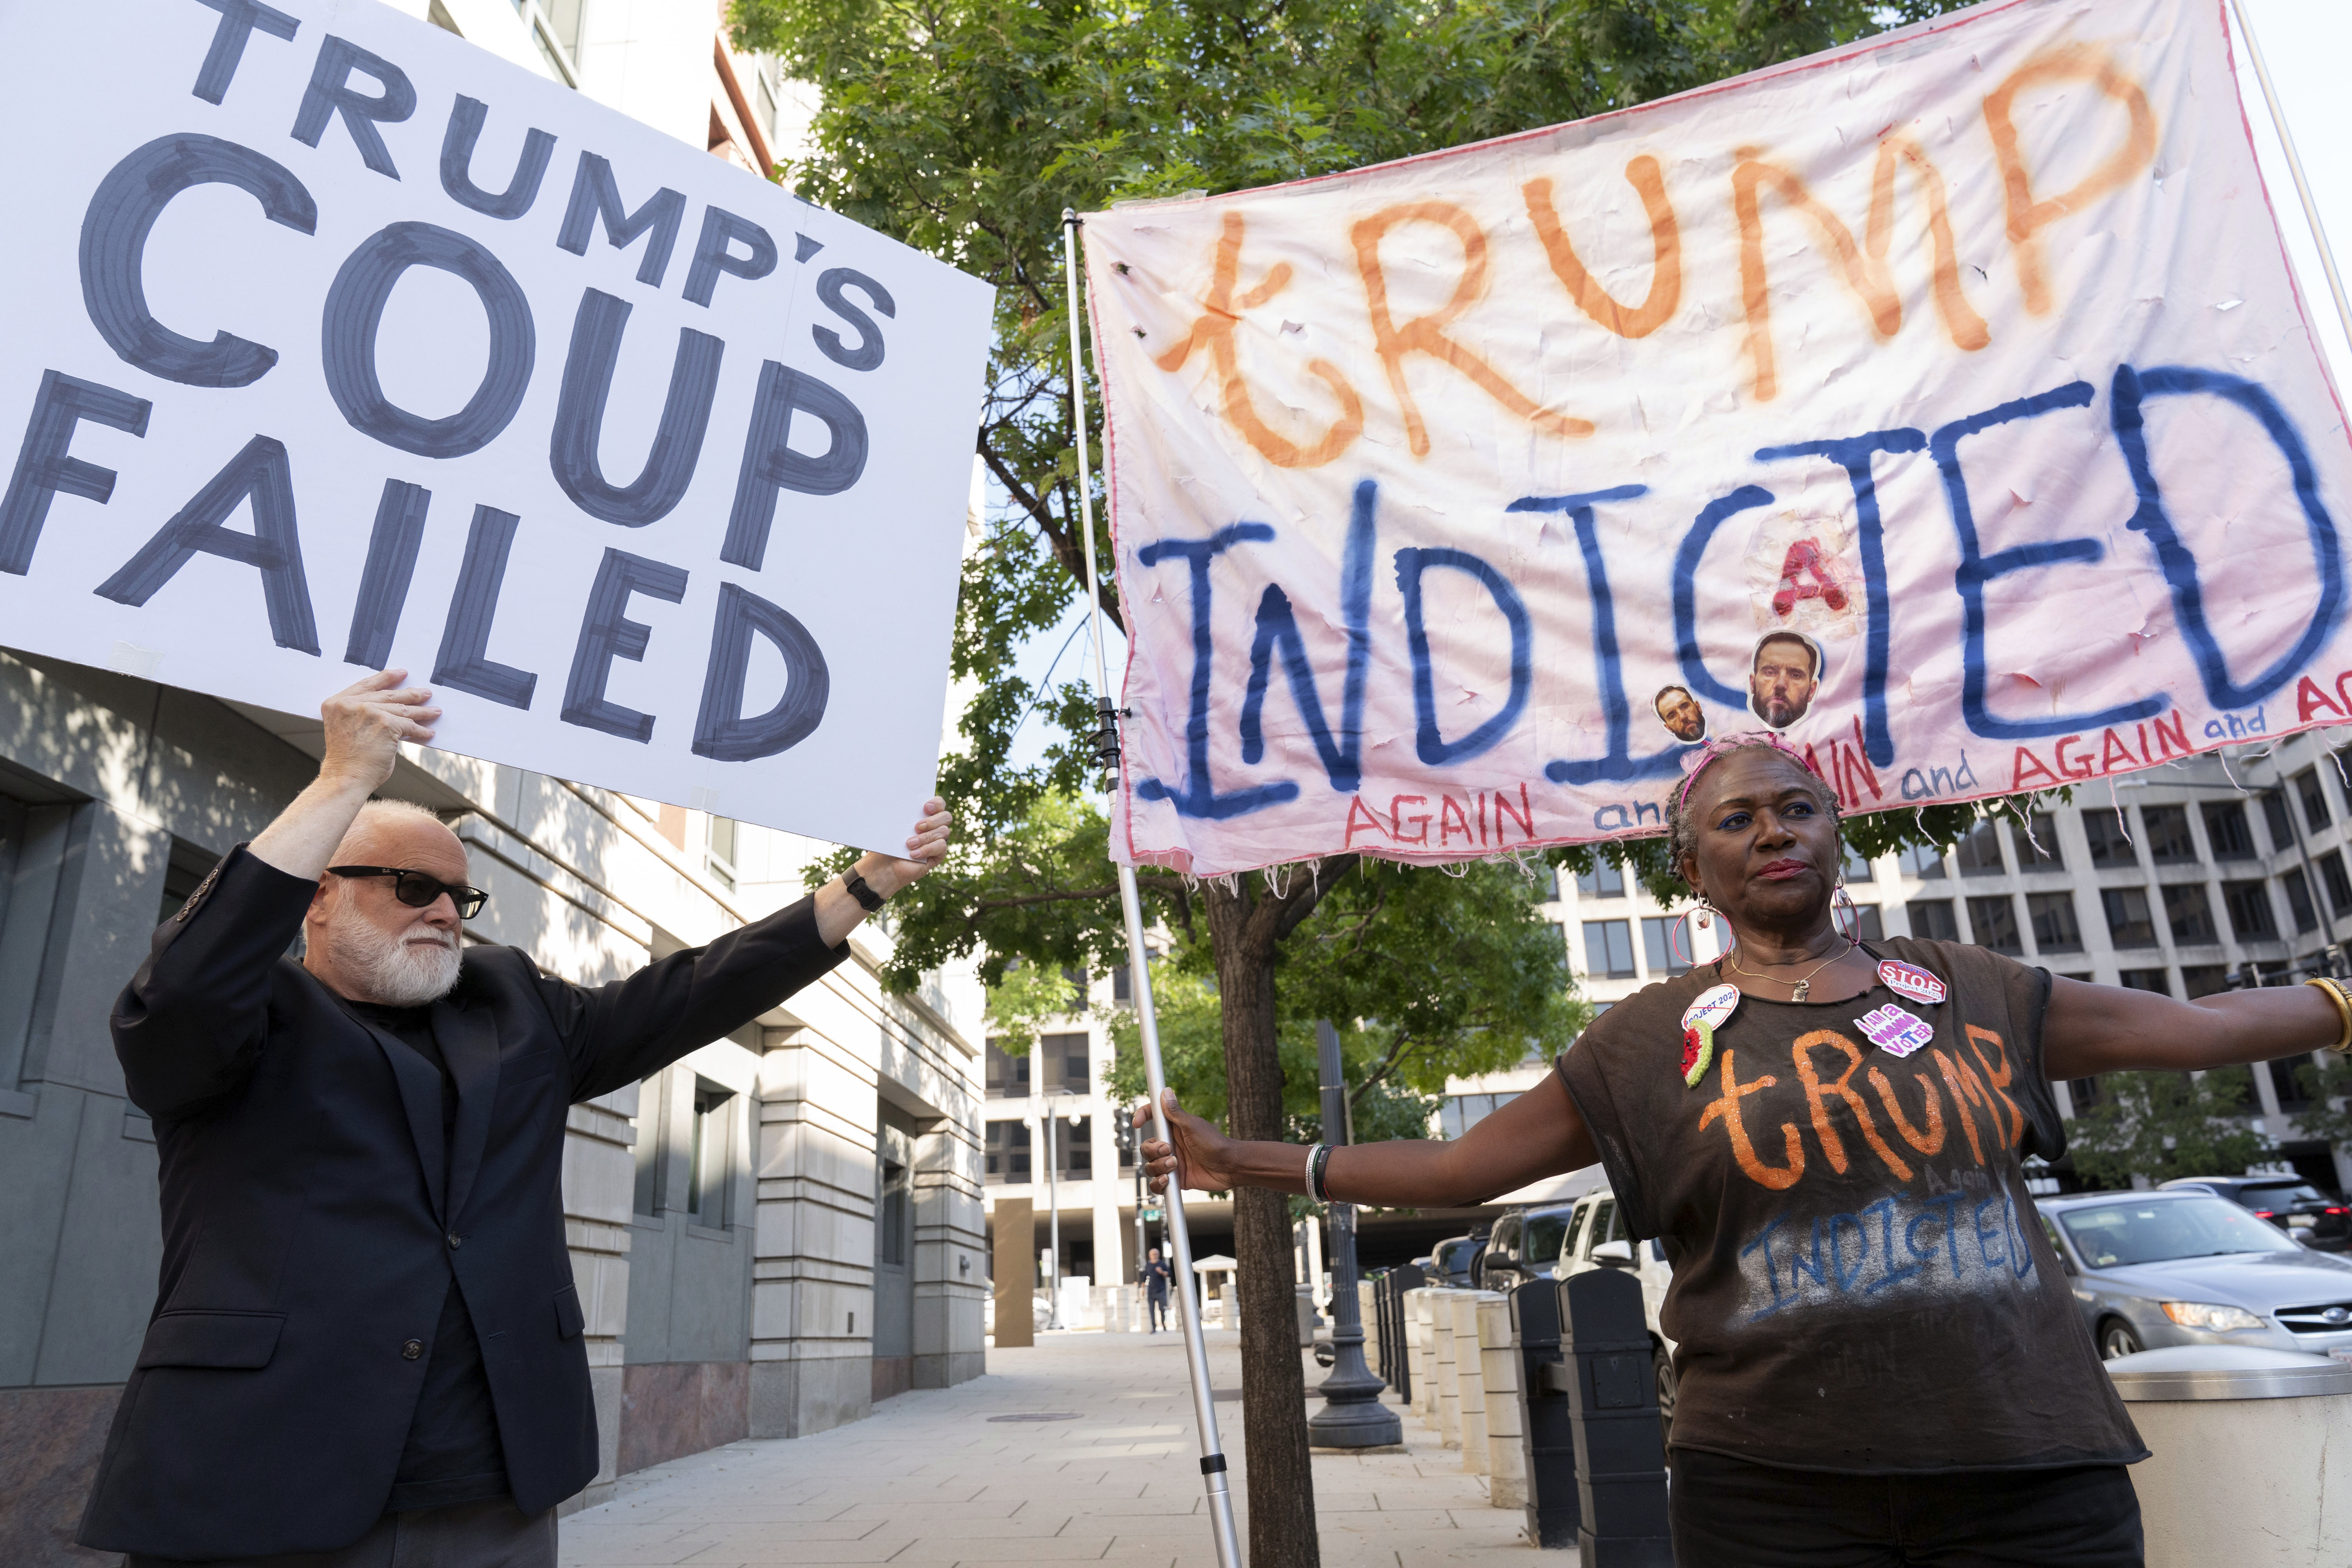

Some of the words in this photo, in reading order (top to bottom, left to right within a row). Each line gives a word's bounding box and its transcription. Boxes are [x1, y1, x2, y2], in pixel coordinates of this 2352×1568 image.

[191, 0, 896, 372] TRUMP'S
[78, 131, 869, 572] COUP
[0, 368, 830, 762] FAILED
[1136, 363, 2343, 821] INDICTED
[1345, 782, 1536, 848] AGAIN
[1593, 799, 1670, 831] an
[1900, 748, 1979, 800] and
[2011, 709, 2193, 789] AGAIN
[2204, 706, 2267, 739] and
[1856, 1021, 1873, 1033] I
[1866, 1012, 1886, 1027] AM
[1882, 965, 1942, 992] STOP
[1889, 979, 1919, 992] Project
[1920, 987, 1940, 999] 2025
[1896, 962, 1929, 978] VOTE
